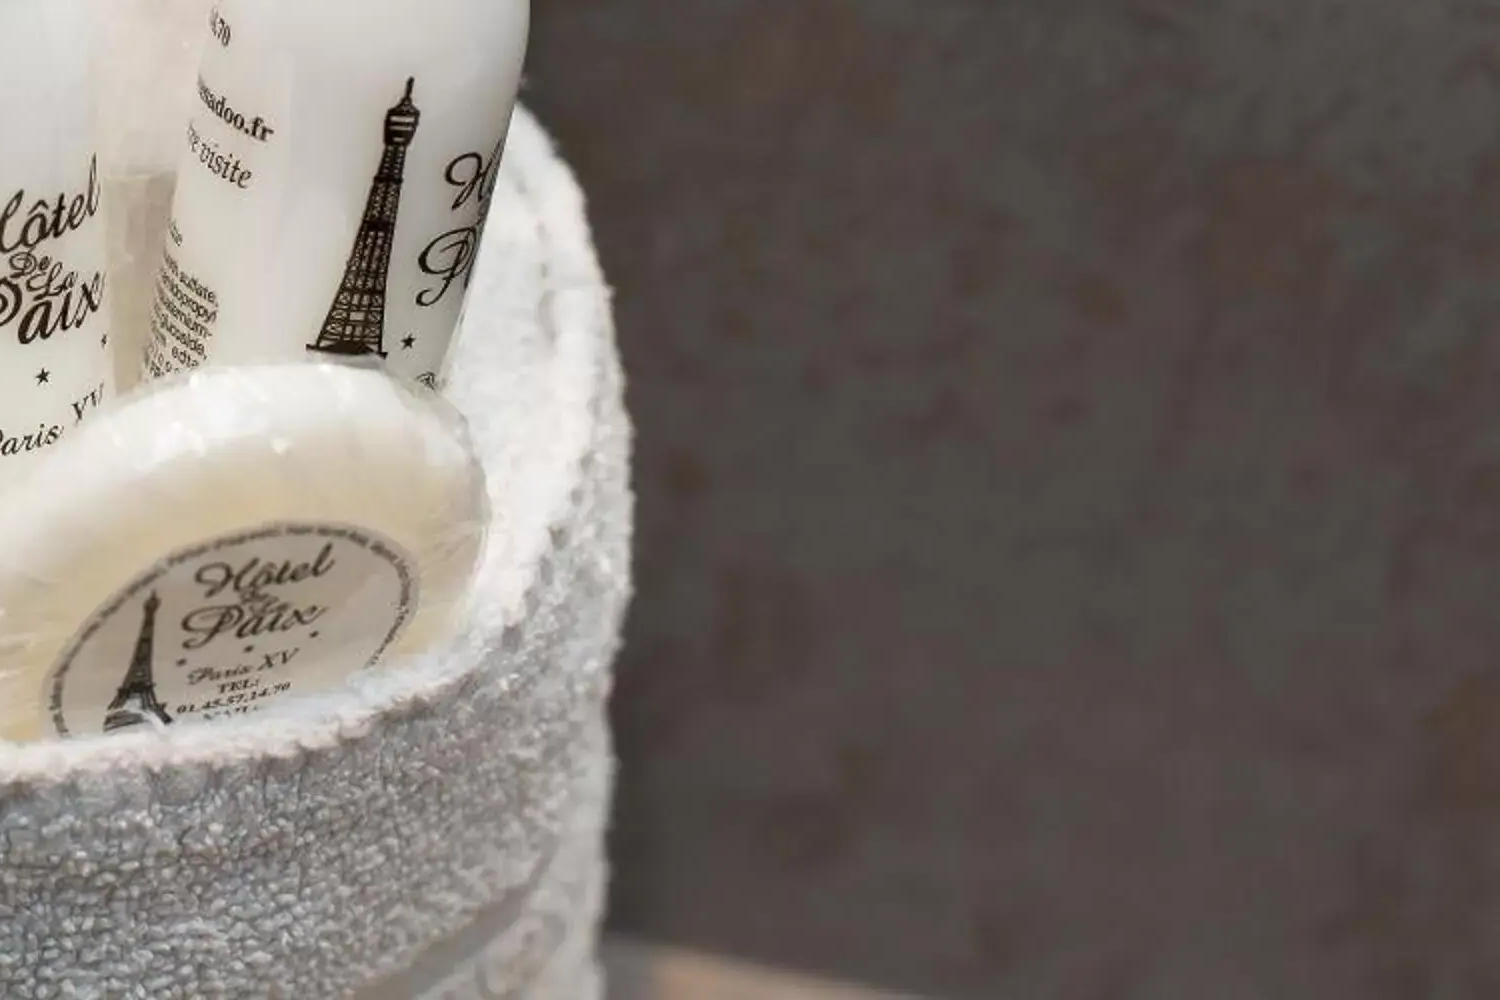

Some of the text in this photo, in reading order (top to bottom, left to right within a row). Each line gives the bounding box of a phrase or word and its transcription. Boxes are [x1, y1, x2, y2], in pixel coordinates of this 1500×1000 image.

[199, 141, 252, 189] visite
[26, 261, 79, 301] La
[255, 647, 301, 672] XV
